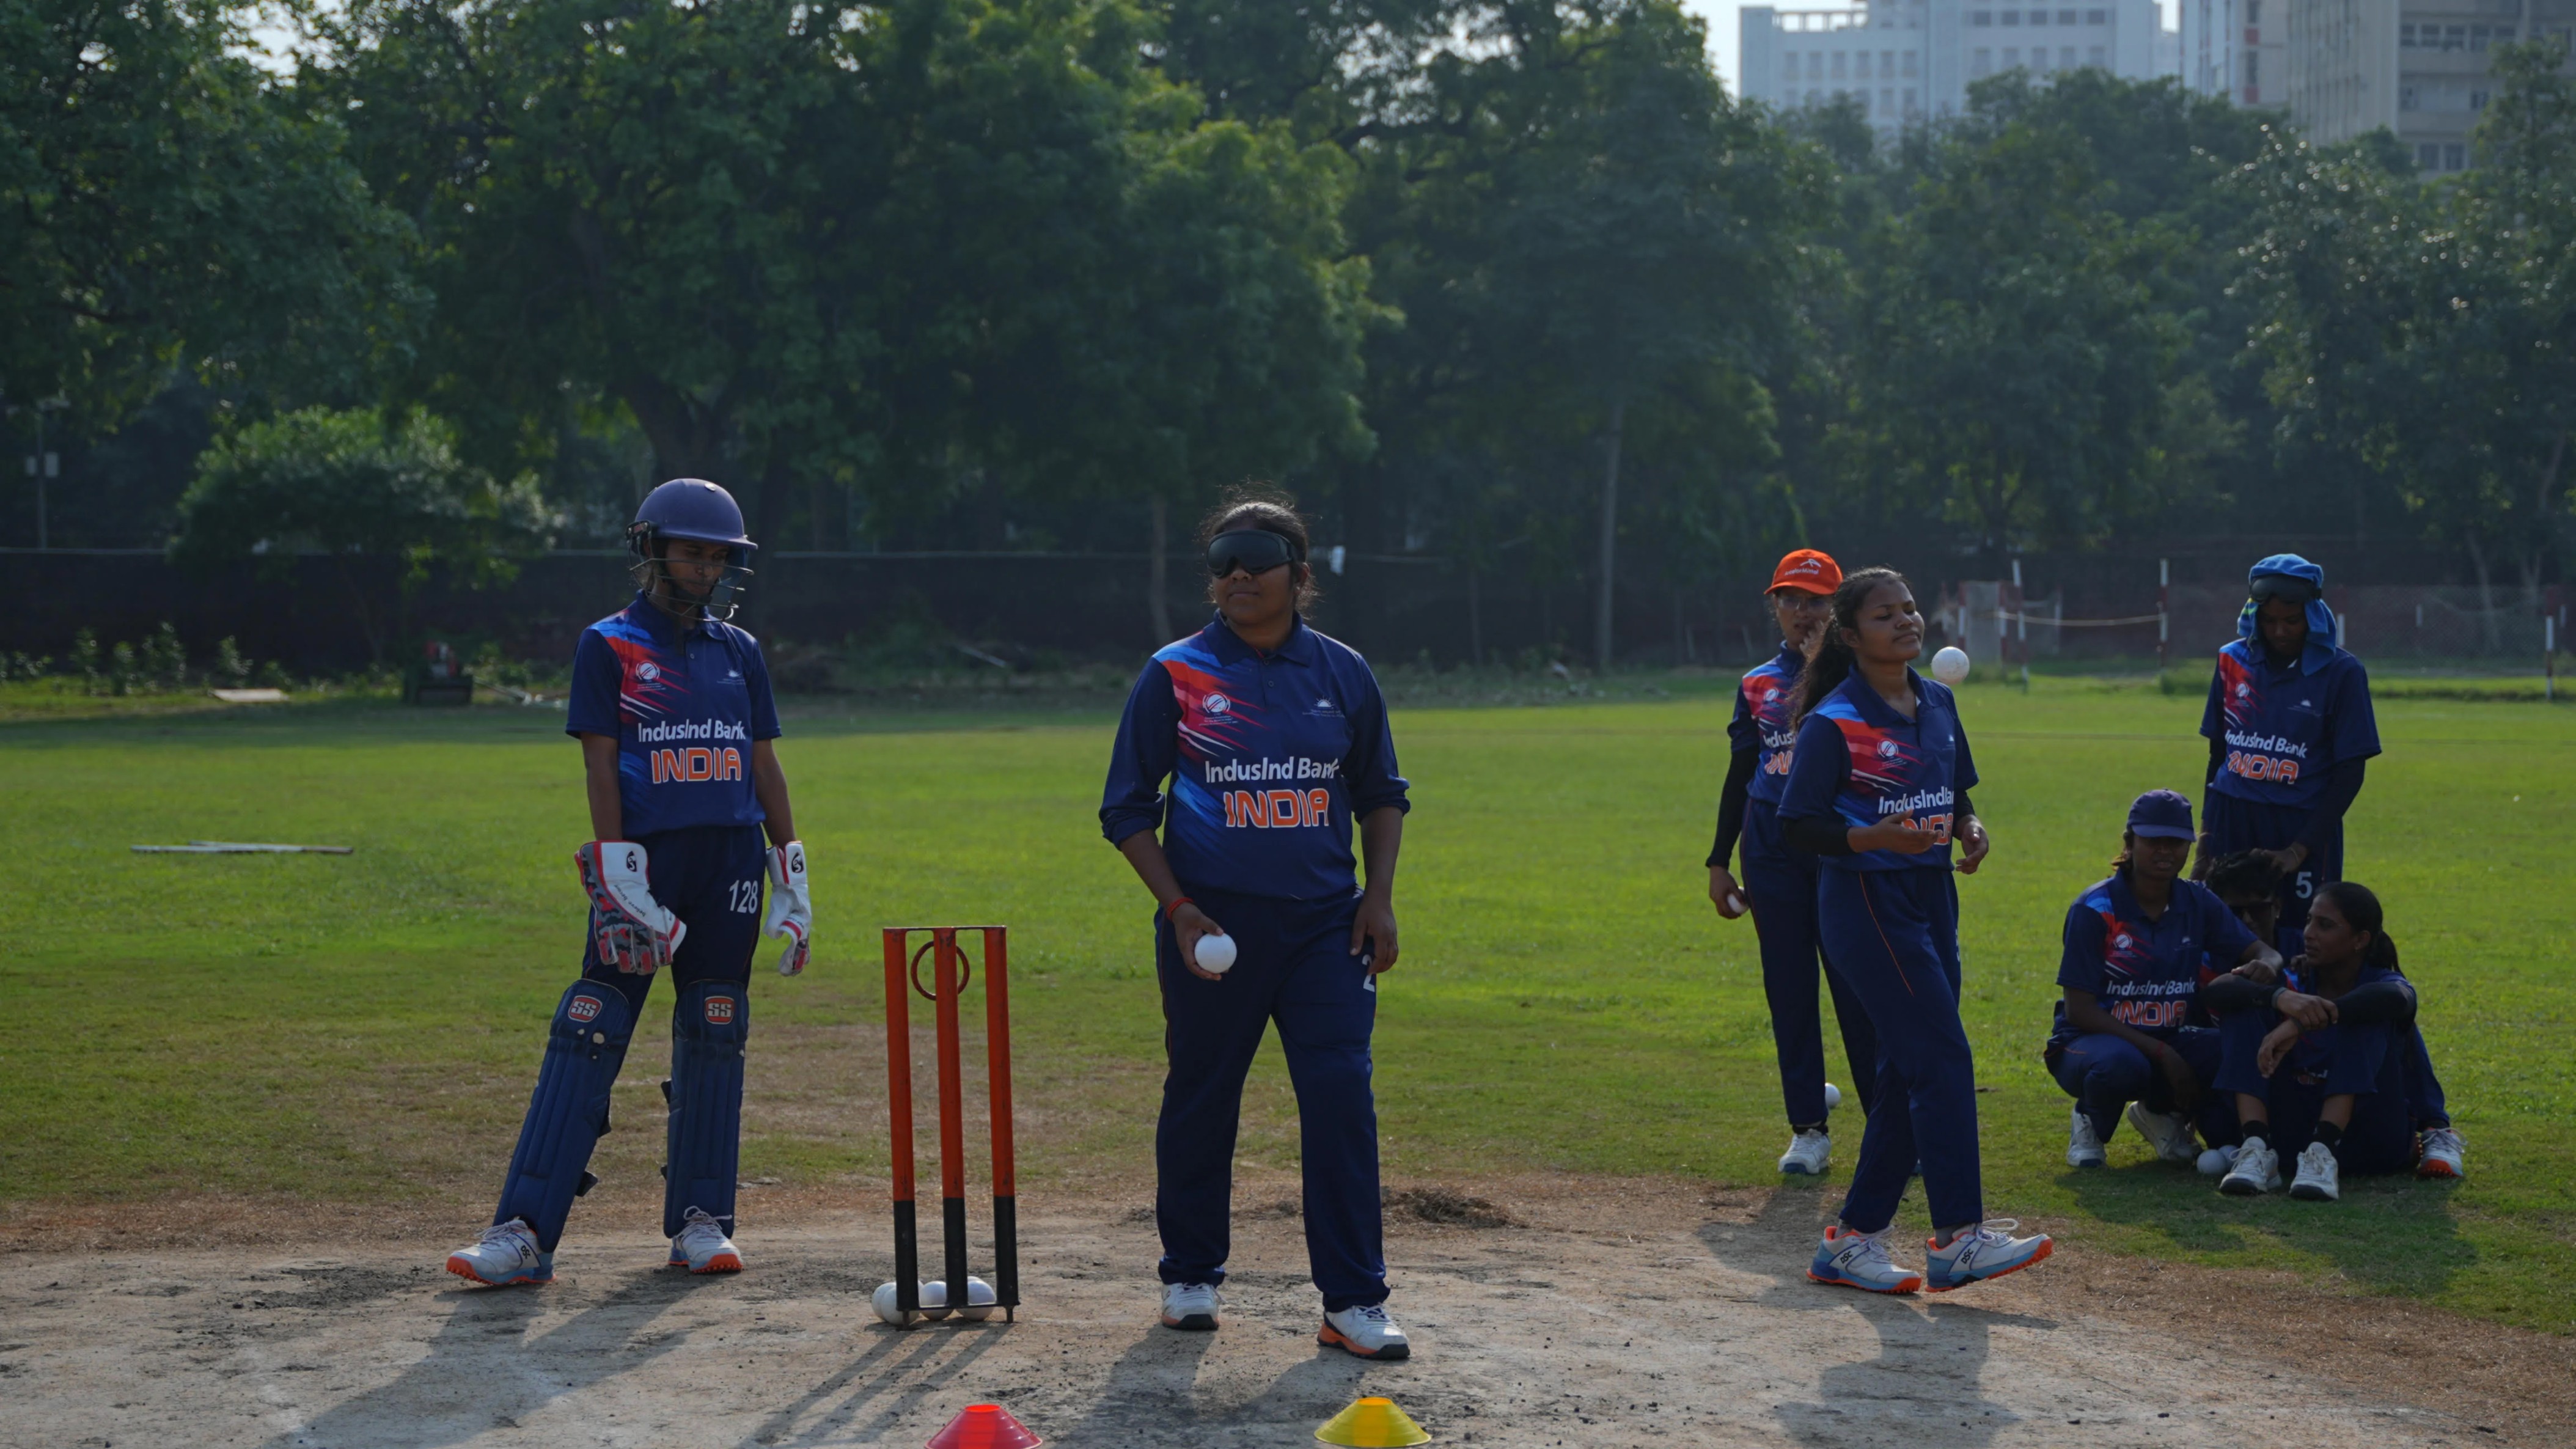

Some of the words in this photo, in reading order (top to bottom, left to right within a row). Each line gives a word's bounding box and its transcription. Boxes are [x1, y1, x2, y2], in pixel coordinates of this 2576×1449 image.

[638, 718, 712, 743] IndusInd
[714, 720, 746, 740] Bank
[2275, 737, 2308, 758] Bank
[650, 746, 742, 784] INDIA
[1205, 756, 1294, 783] IndusInd
[1224, 788, 1330, 829] INDIA
[1878, 786, 1945, 814] IndusInd
[729, 880, 758, 914] 128
[2295, 871, 2313, 899] 5
[2107, 980, 2168, 996] IndusInd
[2165, 977, 2196, 995] Bank
[571, 1001, 597, 1016] SS
[708, 1002, 732, 1018] SS
[2111, 1000, 2187, 1027] INDIA
[1840, 1251, 1853, 1264] DSC
[1961, 1249, 1974, 1264] DSC
